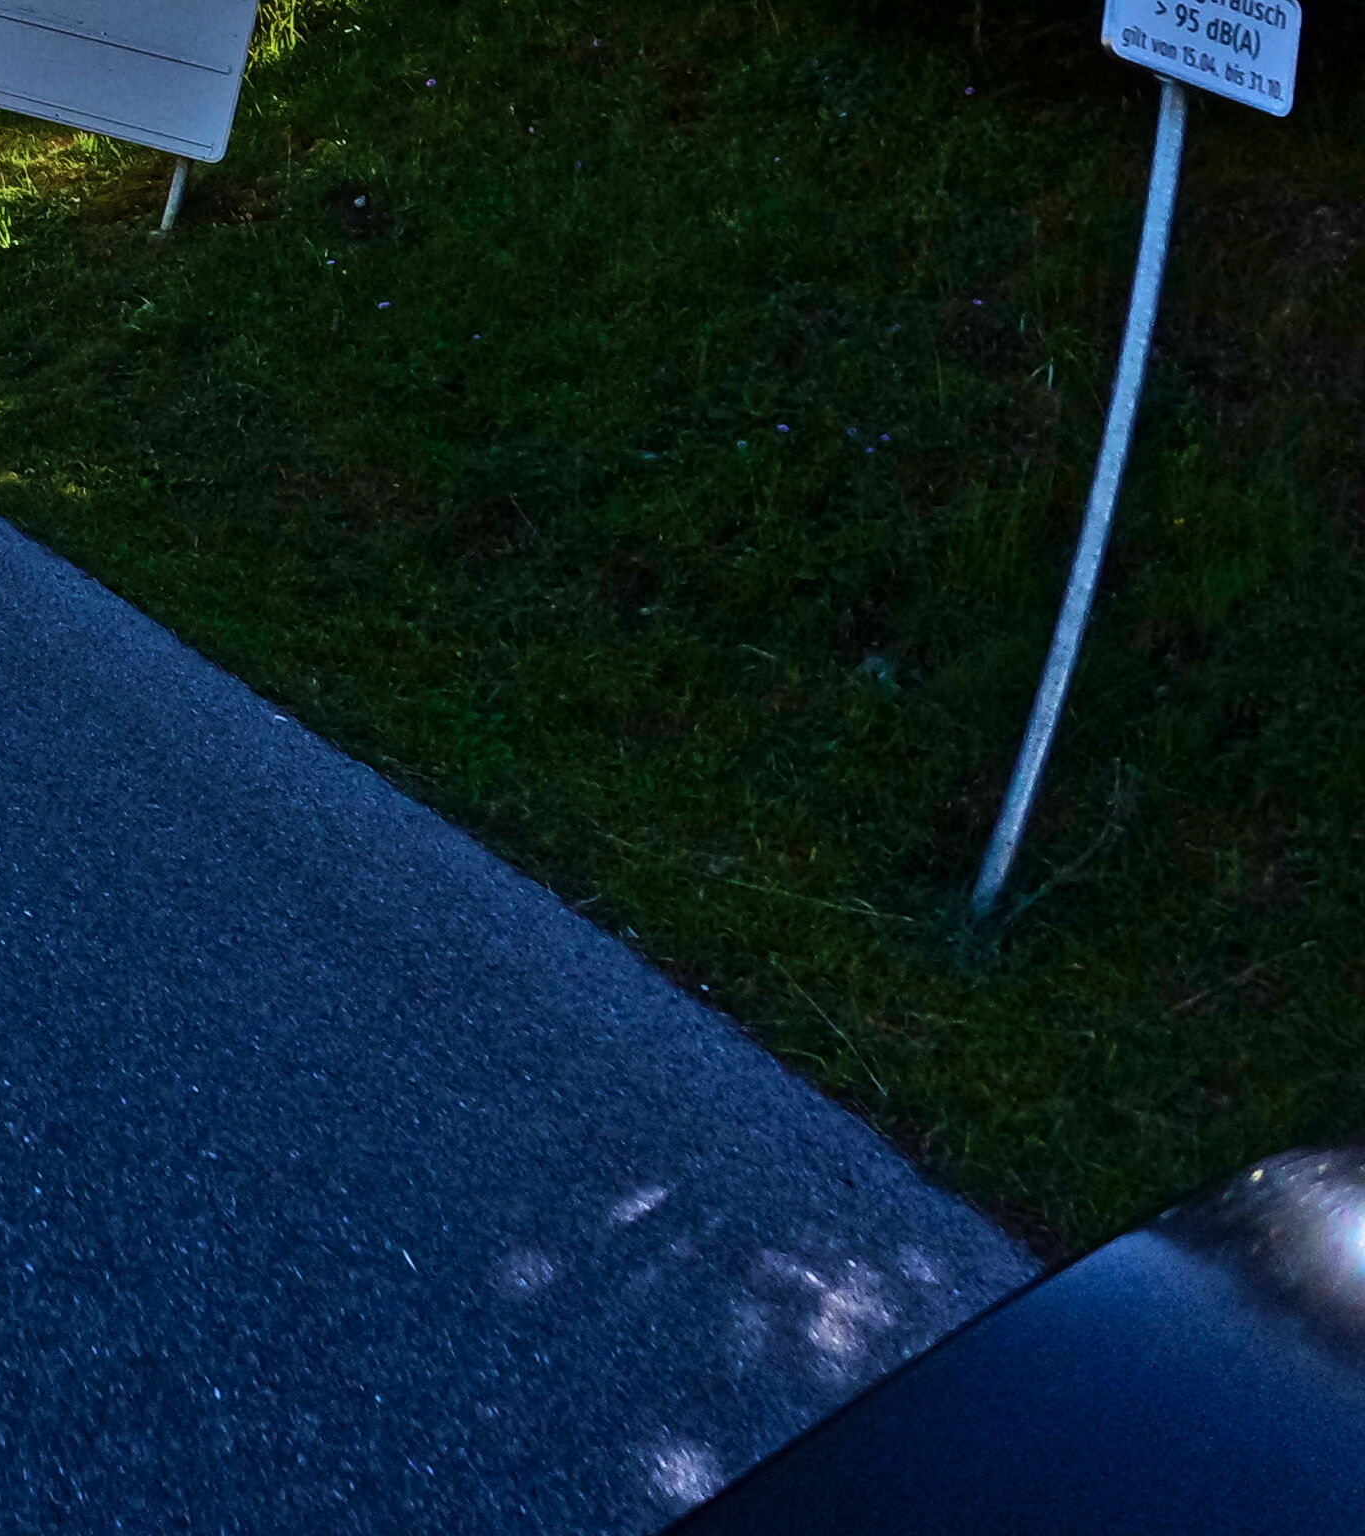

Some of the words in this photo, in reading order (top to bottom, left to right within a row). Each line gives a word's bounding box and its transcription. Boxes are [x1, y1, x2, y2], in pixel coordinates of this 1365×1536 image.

[1121, 25, 1147, 49] gilt
[1151, 38, 1177, 60] von
[1226, 62, 1245, 86] bis
[1175, 3, 1200, 33] 95
[1206, 18, 1261, 60] dB(A)
